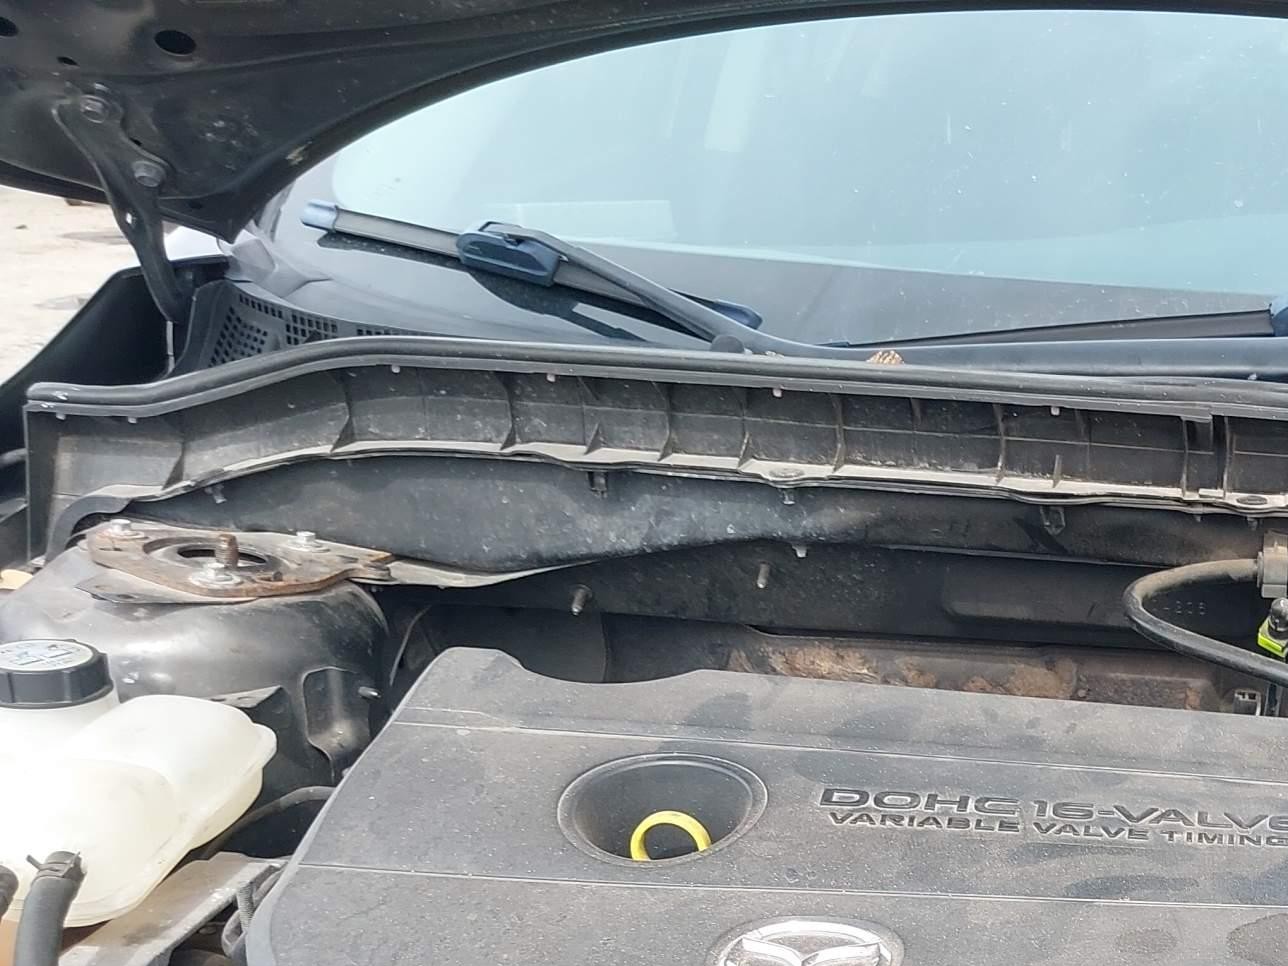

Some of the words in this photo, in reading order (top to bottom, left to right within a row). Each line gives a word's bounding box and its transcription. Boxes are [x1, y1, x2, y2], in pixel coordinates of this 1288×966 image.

[819, 787, 1020, 816] DOHC
[829, 811, 1020, 833] VARIABLE
[1032, 821, 1150, 841] VALVE
